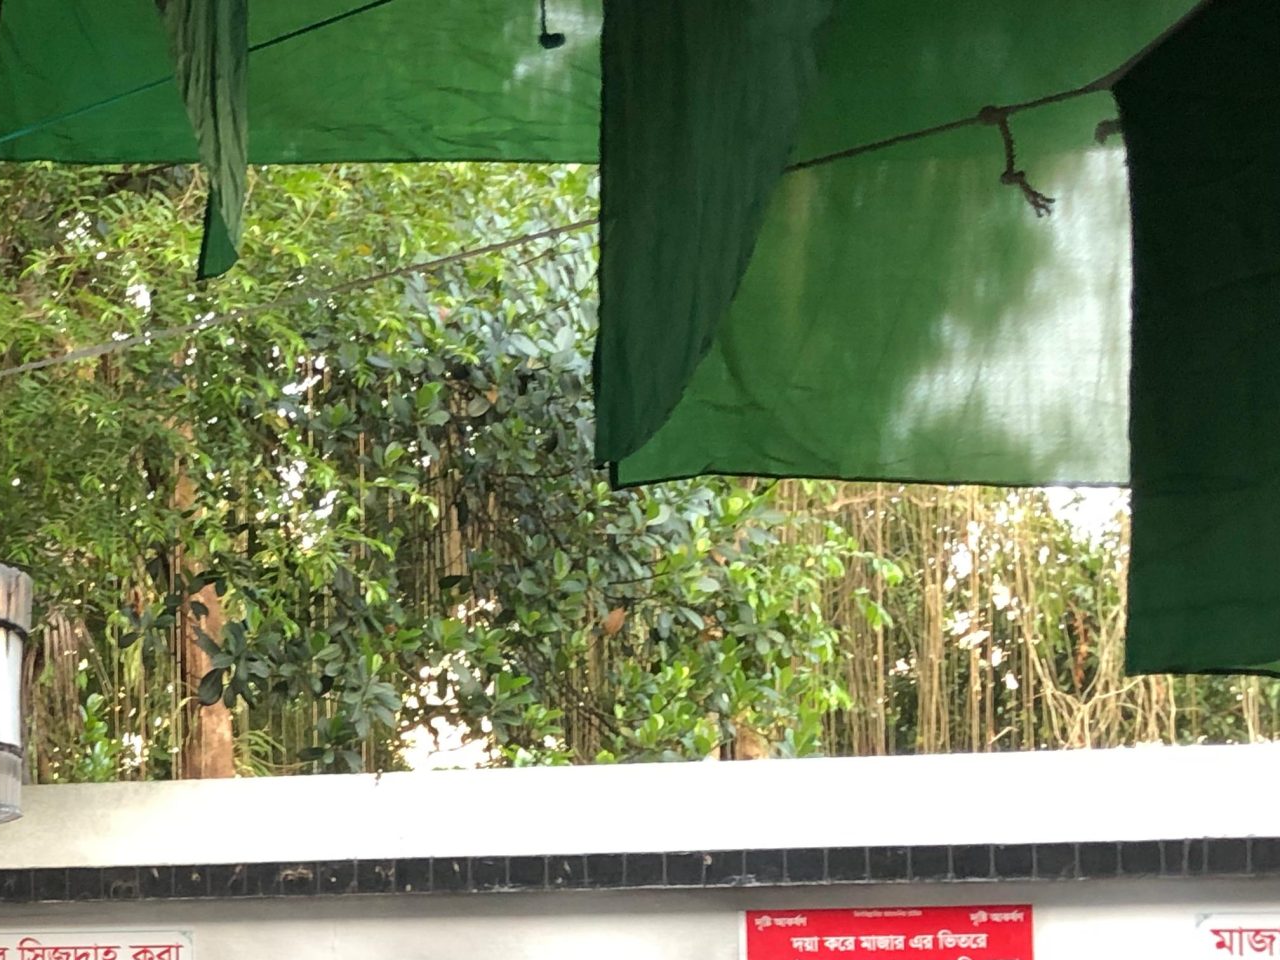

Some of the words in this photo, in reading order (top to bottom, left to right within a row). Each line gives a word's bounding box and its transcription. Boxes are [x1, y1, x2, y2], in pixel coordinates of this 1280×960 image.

[823, 936, 856, 951] করে
[859, 935, 905, 951] মাজার
[909, 935, 934, 950] এর
[937, 929, 988, 950] ভিতরে
